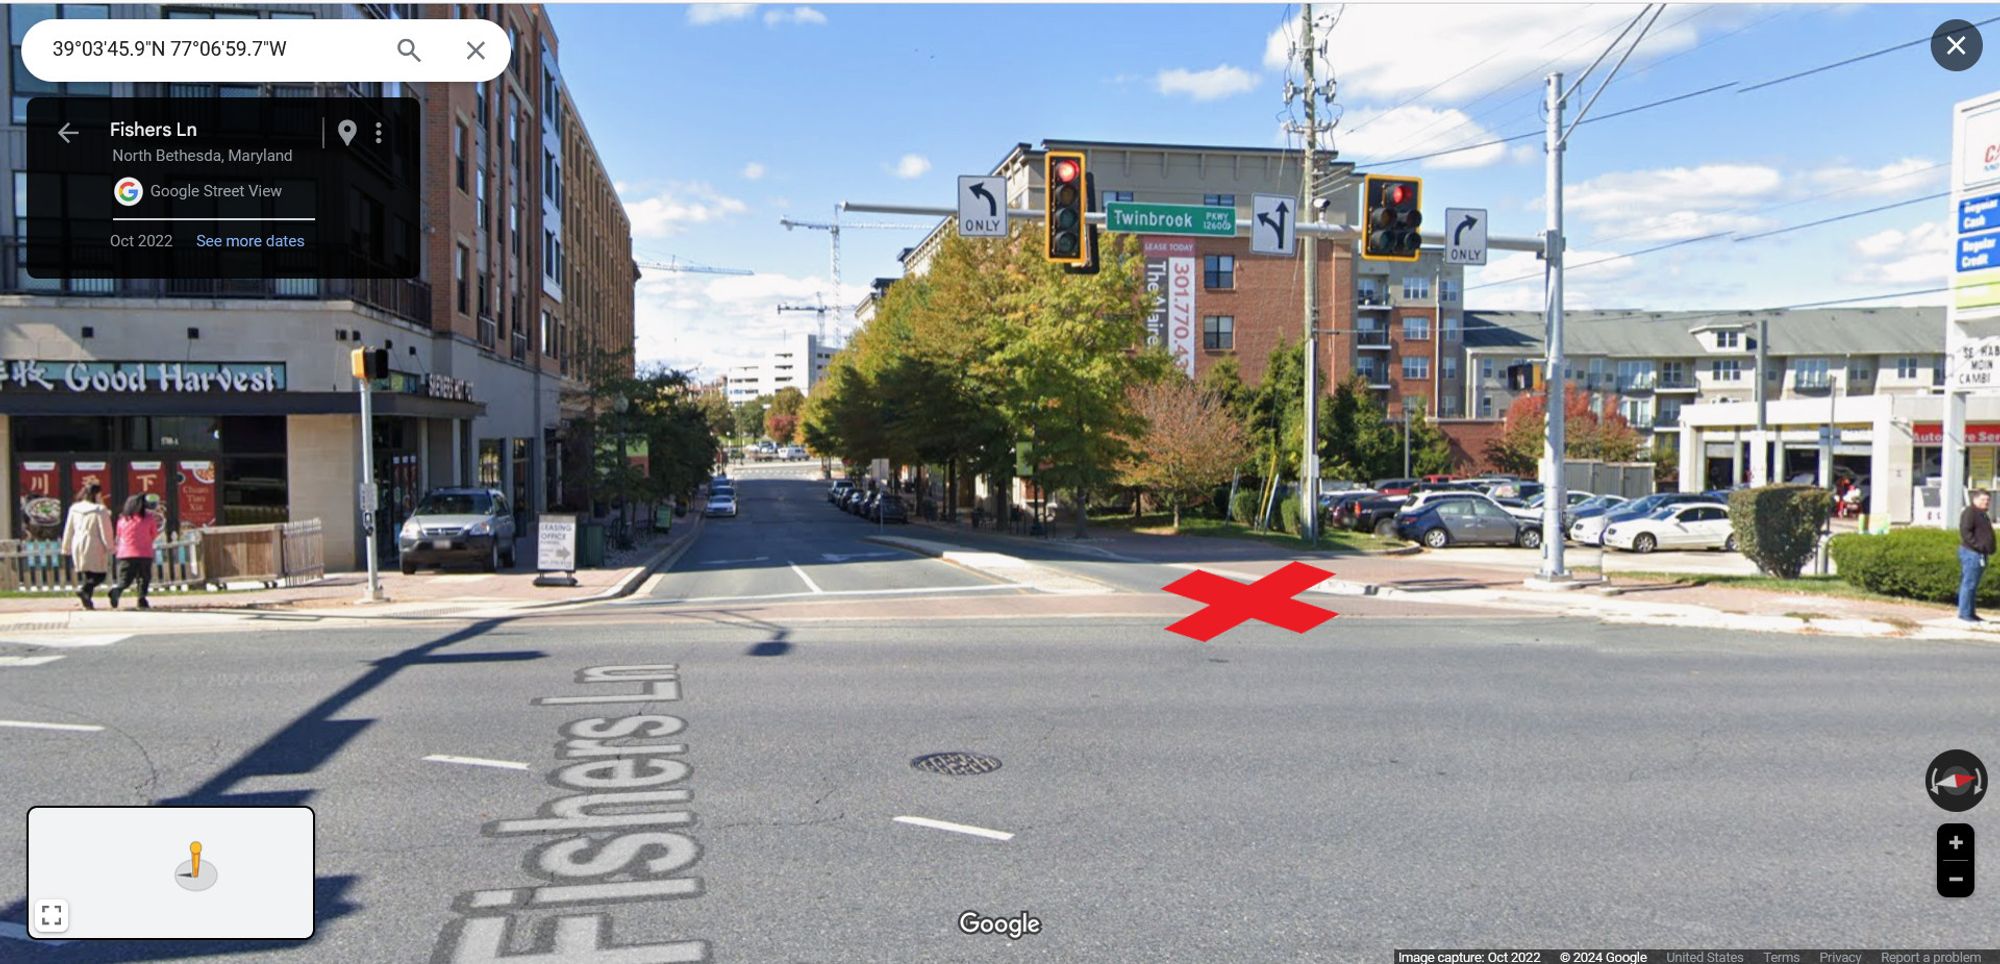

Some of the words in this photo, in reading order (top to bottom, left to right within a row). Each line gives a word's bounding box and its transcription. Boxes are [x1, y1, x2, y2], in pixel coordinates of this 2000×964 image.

[966, 219, 1000, 231] ONLY
[1114, 209, 1193, 228] Twinbrook
[1206, 212, 1229, 222] PKWY
[1145, 243, 1167, 251] LEASE
[1170, 243, 1194, 251] TODAY
[1451, 249, 1481, 260] ONLY
[1147, 261, 1167, 292] The
[65, 362, 147, 392] Good
[160, 363, 275, 392] Harvest
[136, 474, 157, 492] 下
[541, 524, 572, 532] LEASING
